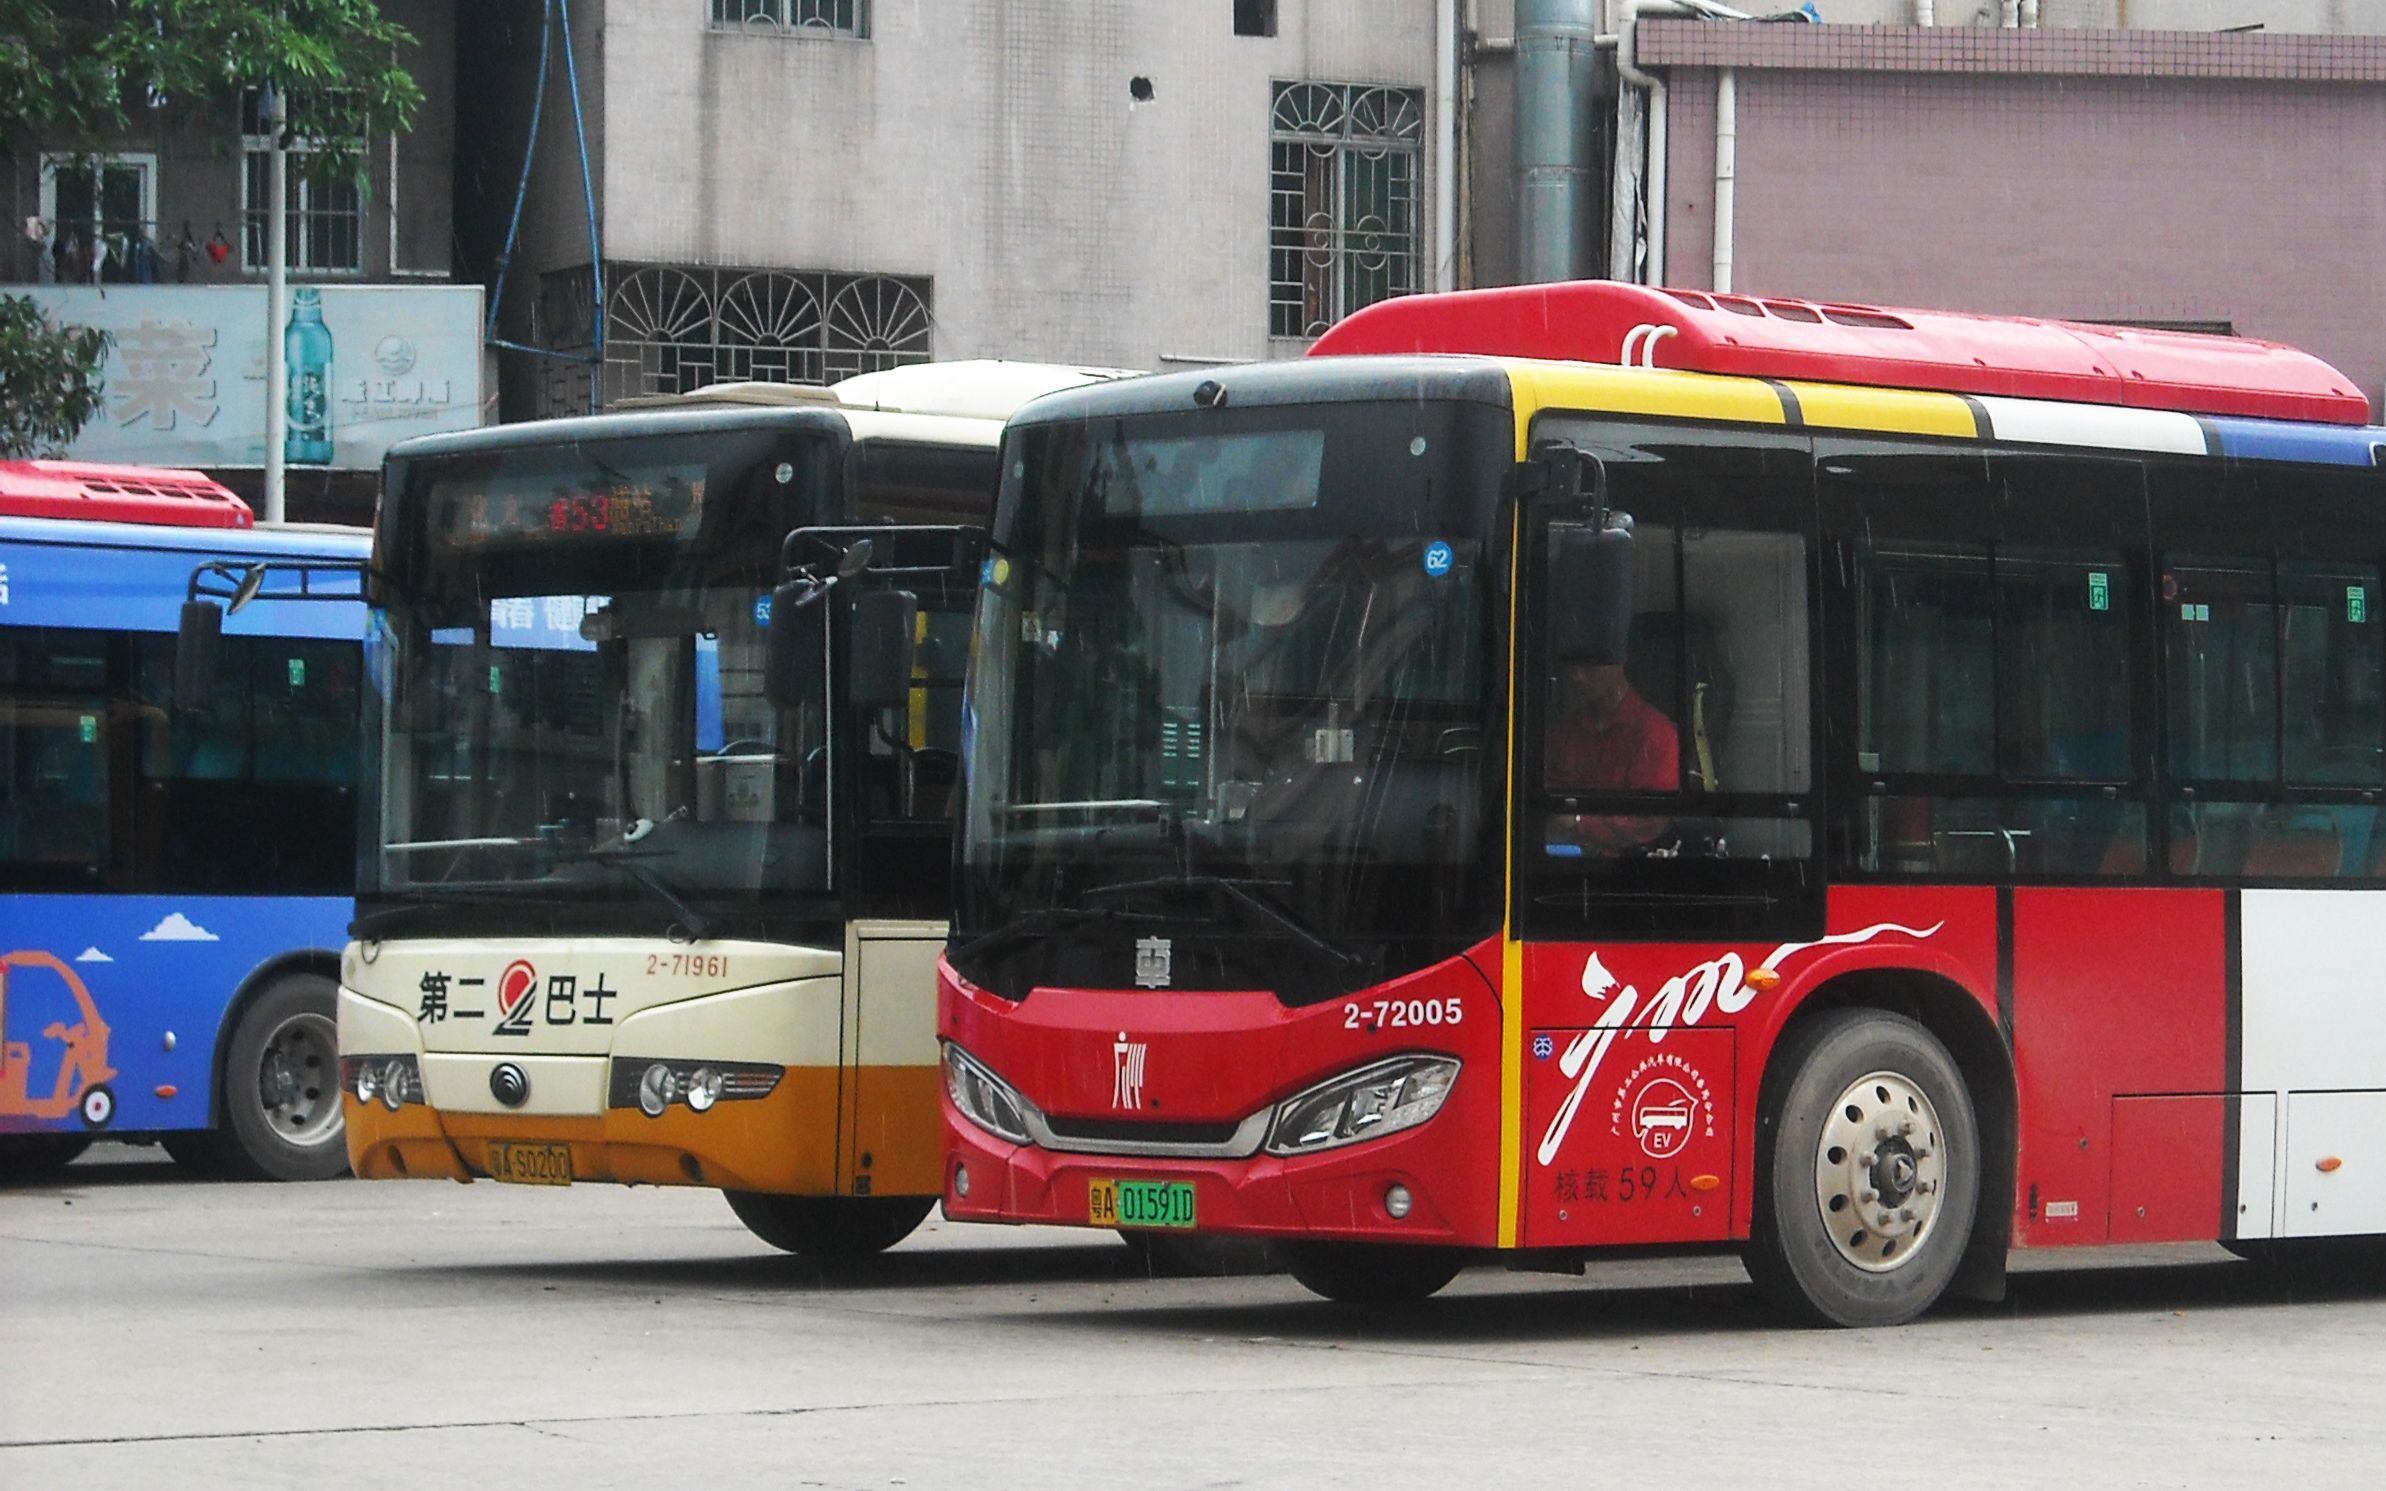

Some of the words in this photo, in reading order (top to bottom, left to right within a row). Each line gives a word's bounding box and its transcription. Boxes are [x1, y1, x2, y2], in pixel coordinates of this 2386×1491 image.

[1427, 549, 1448, 569] 62
[645, 953, 729, 978] 2-71961
[417, 970, 485, 1024] 第二
[545, 972, 618, 1026] 巴士
[1343, 998, 1463, 1029] 2-72005
[1653, 1132, 1671, 1148] EV
[1123, 1187, 1194, 1222] 01591D
